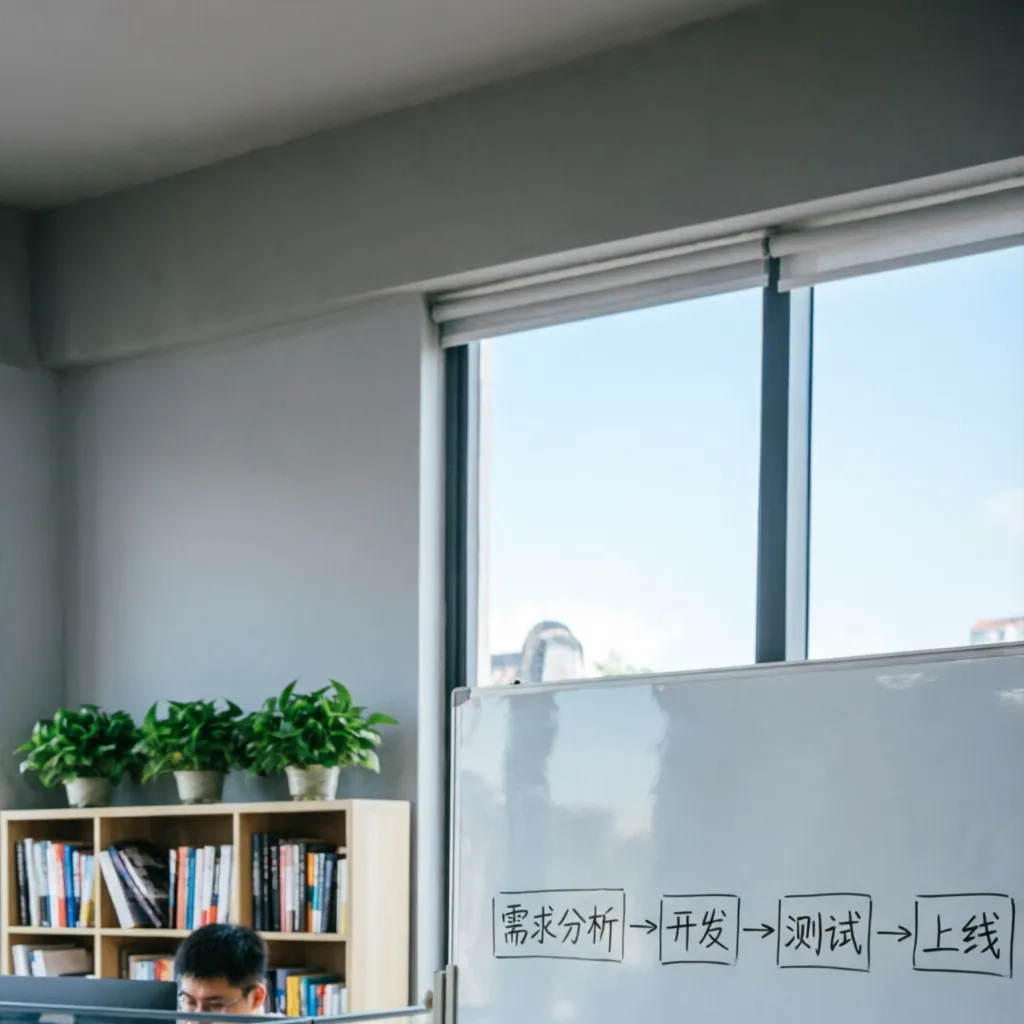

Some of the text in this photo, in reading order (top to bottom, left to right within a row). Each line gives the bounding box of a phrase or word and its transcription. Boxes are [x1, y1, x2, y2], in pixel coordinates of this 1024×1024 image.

[501, 904, 1001, 960] 需求分析 开发 测试 上线
